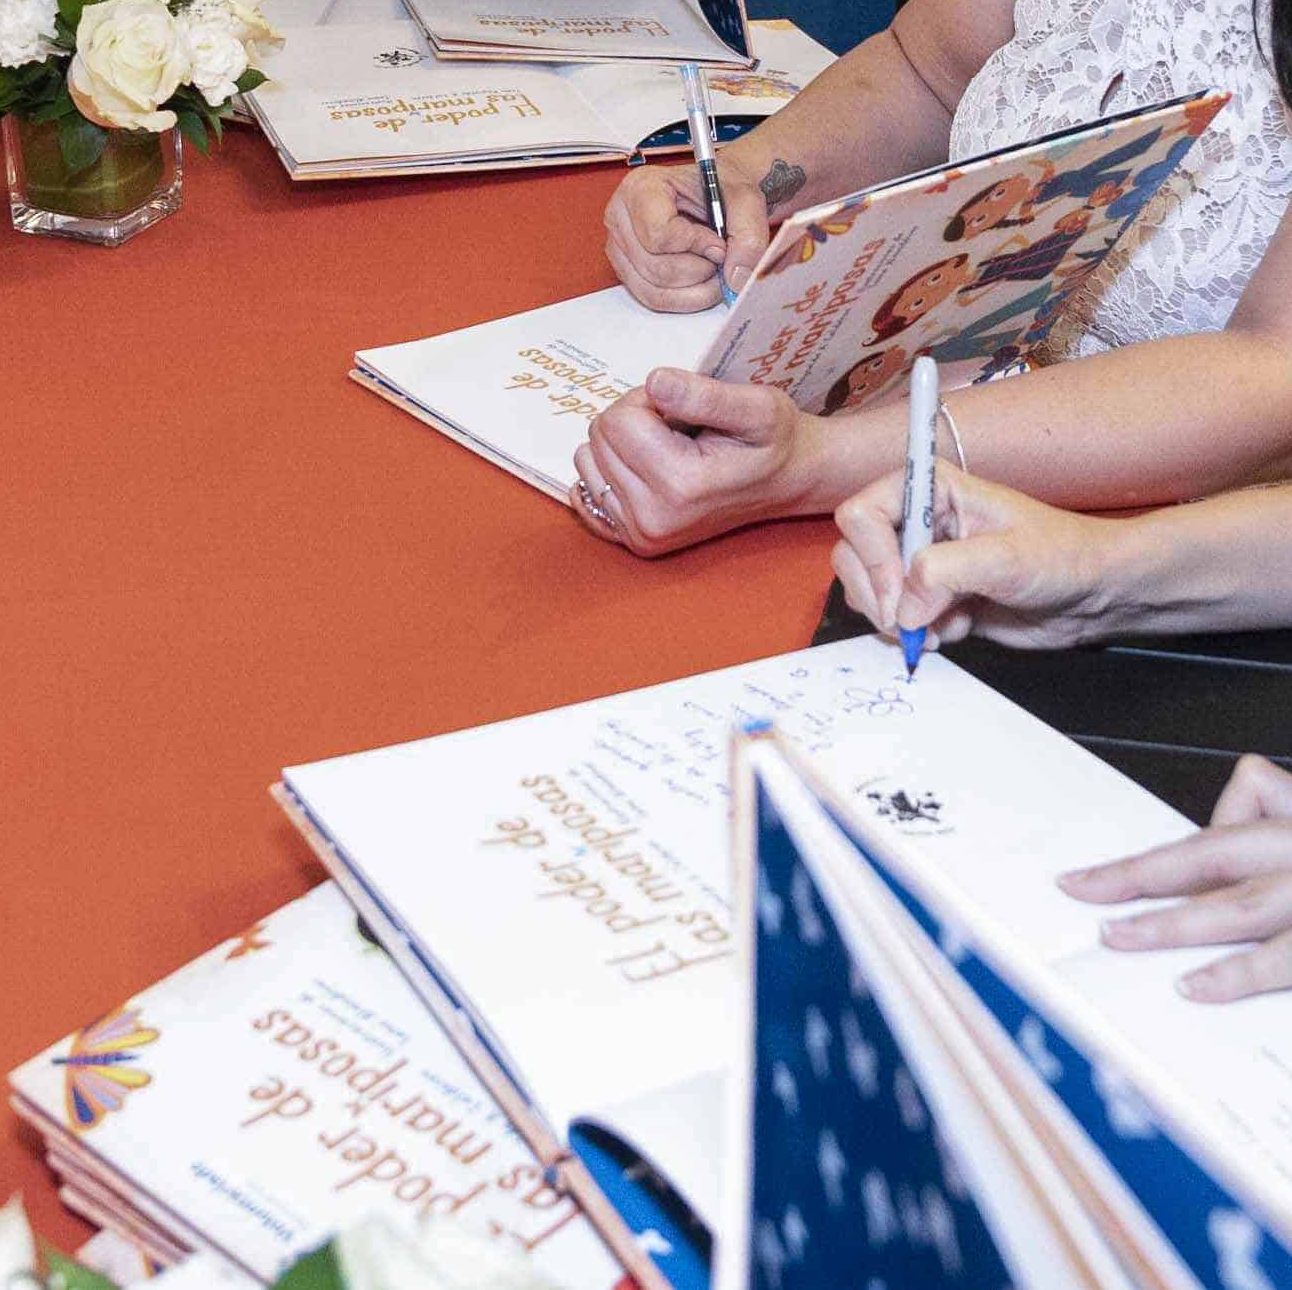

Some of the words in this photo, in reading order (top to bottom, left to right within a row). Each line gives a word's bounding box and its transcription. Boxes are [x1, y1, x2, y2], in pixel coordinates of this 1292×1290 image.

[329, 97, 476, 122] mariposas
[373, 116, 407, 133] de
[420, 102, 501, 126] poder
[504, 371, 549, 390] de
[480, 816, 547, 848] de
[519, 773, 684, 903] mariposas
[536, 861, 669, 933] poder
[239, 1075, 313, 1127] de
[251, 1008, 493, 1164] mariposas
